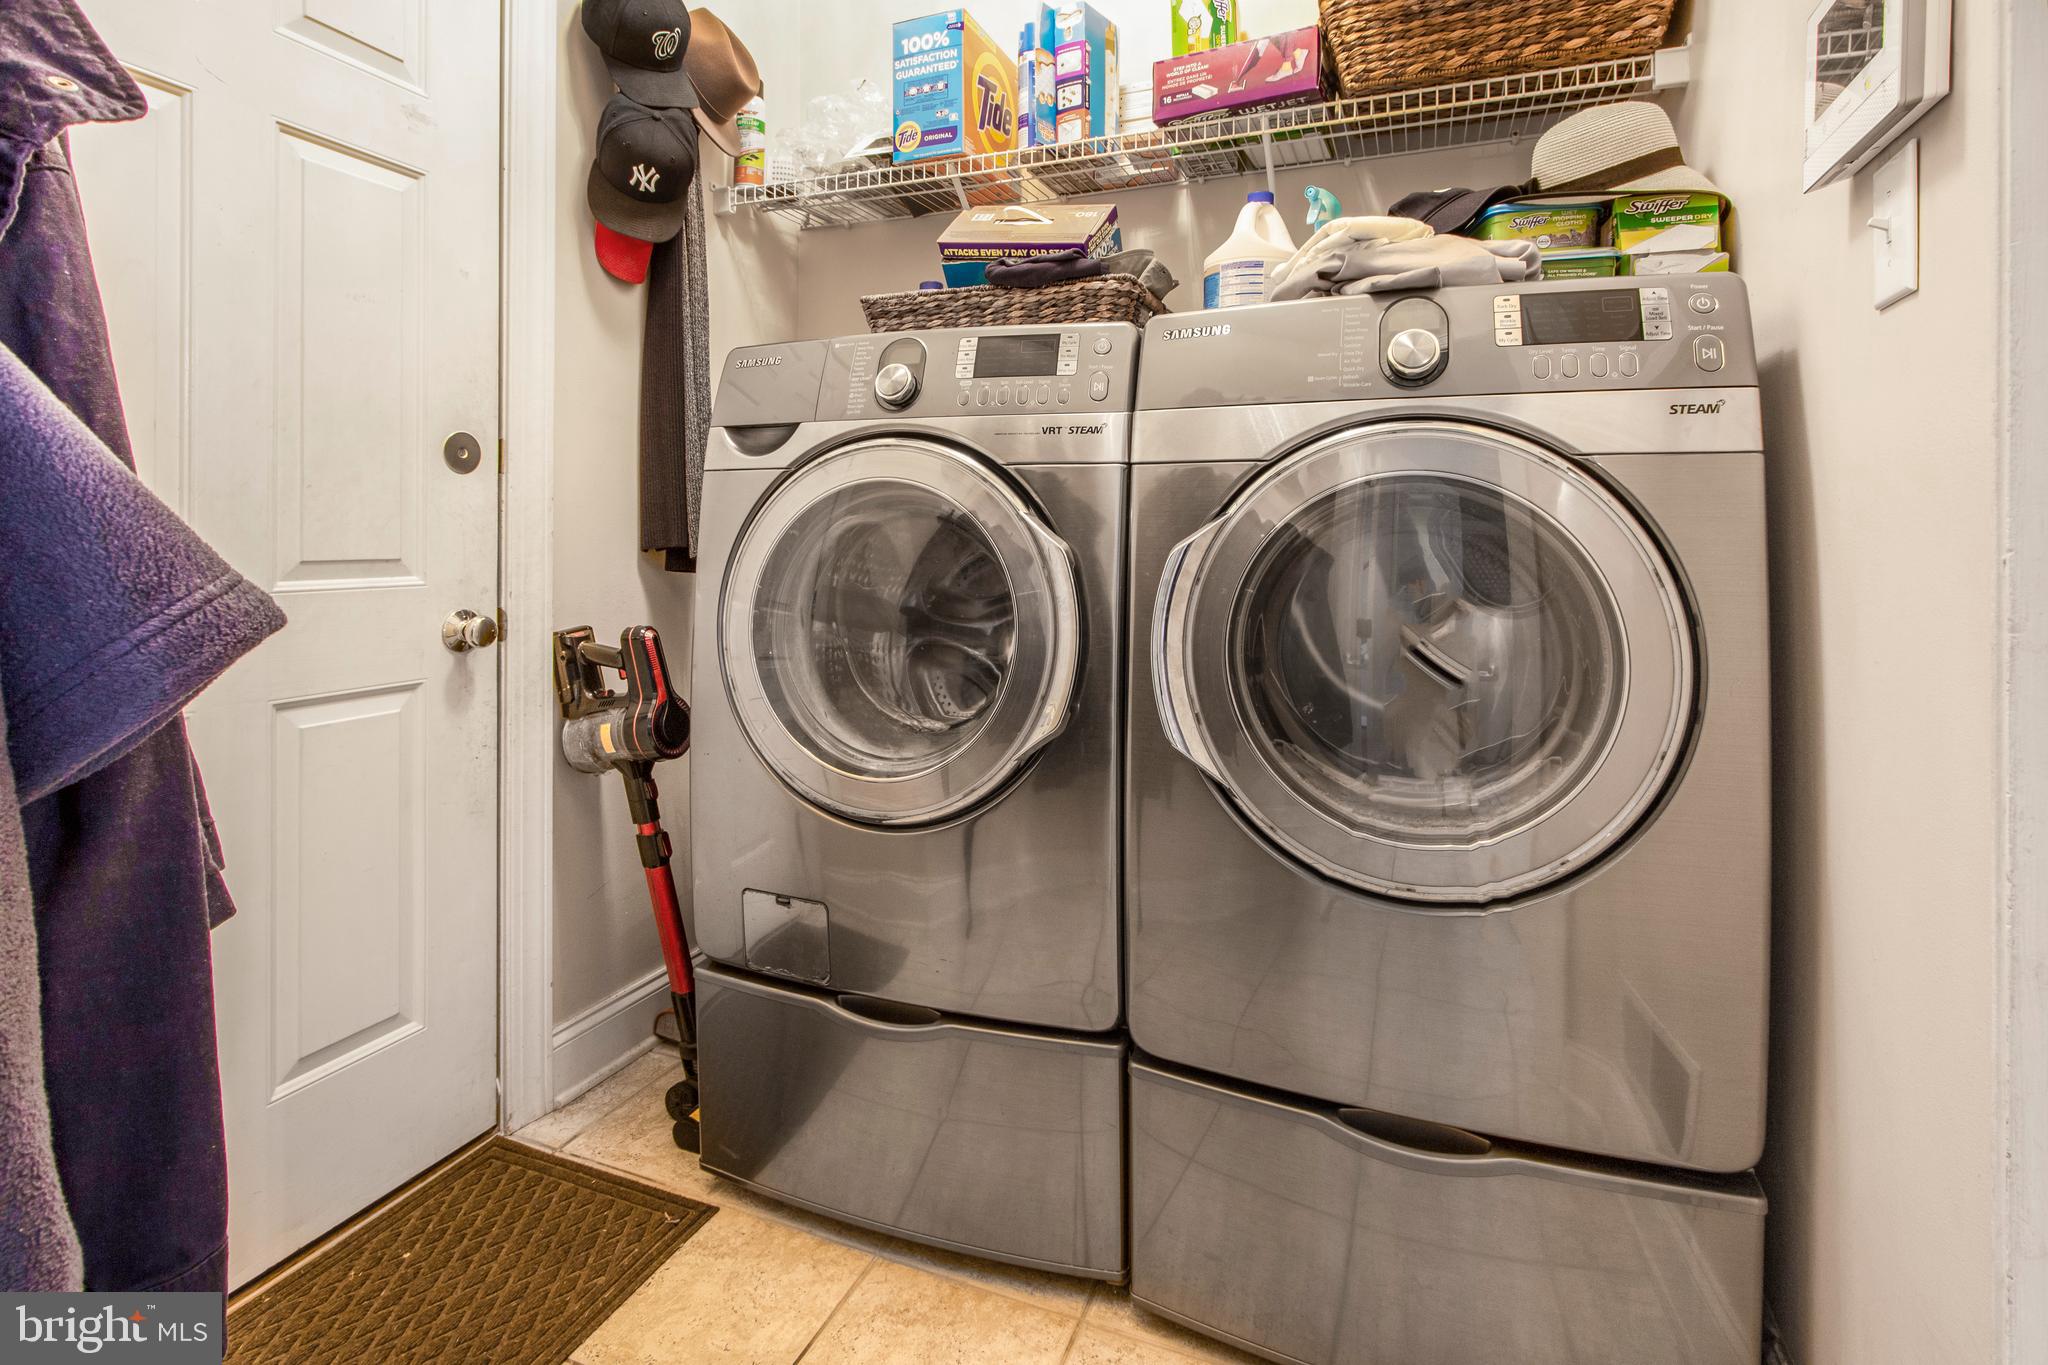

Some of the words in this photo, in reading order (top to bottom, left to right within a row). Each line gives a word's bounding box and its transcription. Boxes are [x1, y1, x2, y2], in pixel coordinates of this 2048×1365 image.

[901, 30, 950, 54] 100%
[894, 49, 958, 69] SATISFACTION
[976, 74, 1014, 138] Tide
[1163, 96, 1173, 104] 16
[1239, 97, 1307, 115] WETJET
[898, 130, 918, 148] Tide
[924, 133, 953, 142] ORIGINAL
[629, 163, 661, 193] NY
[1624, 199, 1689, 215] Swiffer
[1509, 214, 1551, 229] Swiffer
[1650, 214, 1694, 223] SWEEPER
[943, 248, 979, 257] ATTACKS
[979, 249, 1003, 257] EVEN
[1004, 249, 1010, 257] 7
[1011, 249, 1028, 257] DAY
[1029, 249, 1048, 257] OLD
[1163, 324, 1231, 341] SAMSUNG
[735, 356, 782, 369] SAMSUNG
[1669, 403, 1721, 415] STEAM
[1041, 426, 1062, 435] VRT
[1067, 426, 1103, 434] STEAM
